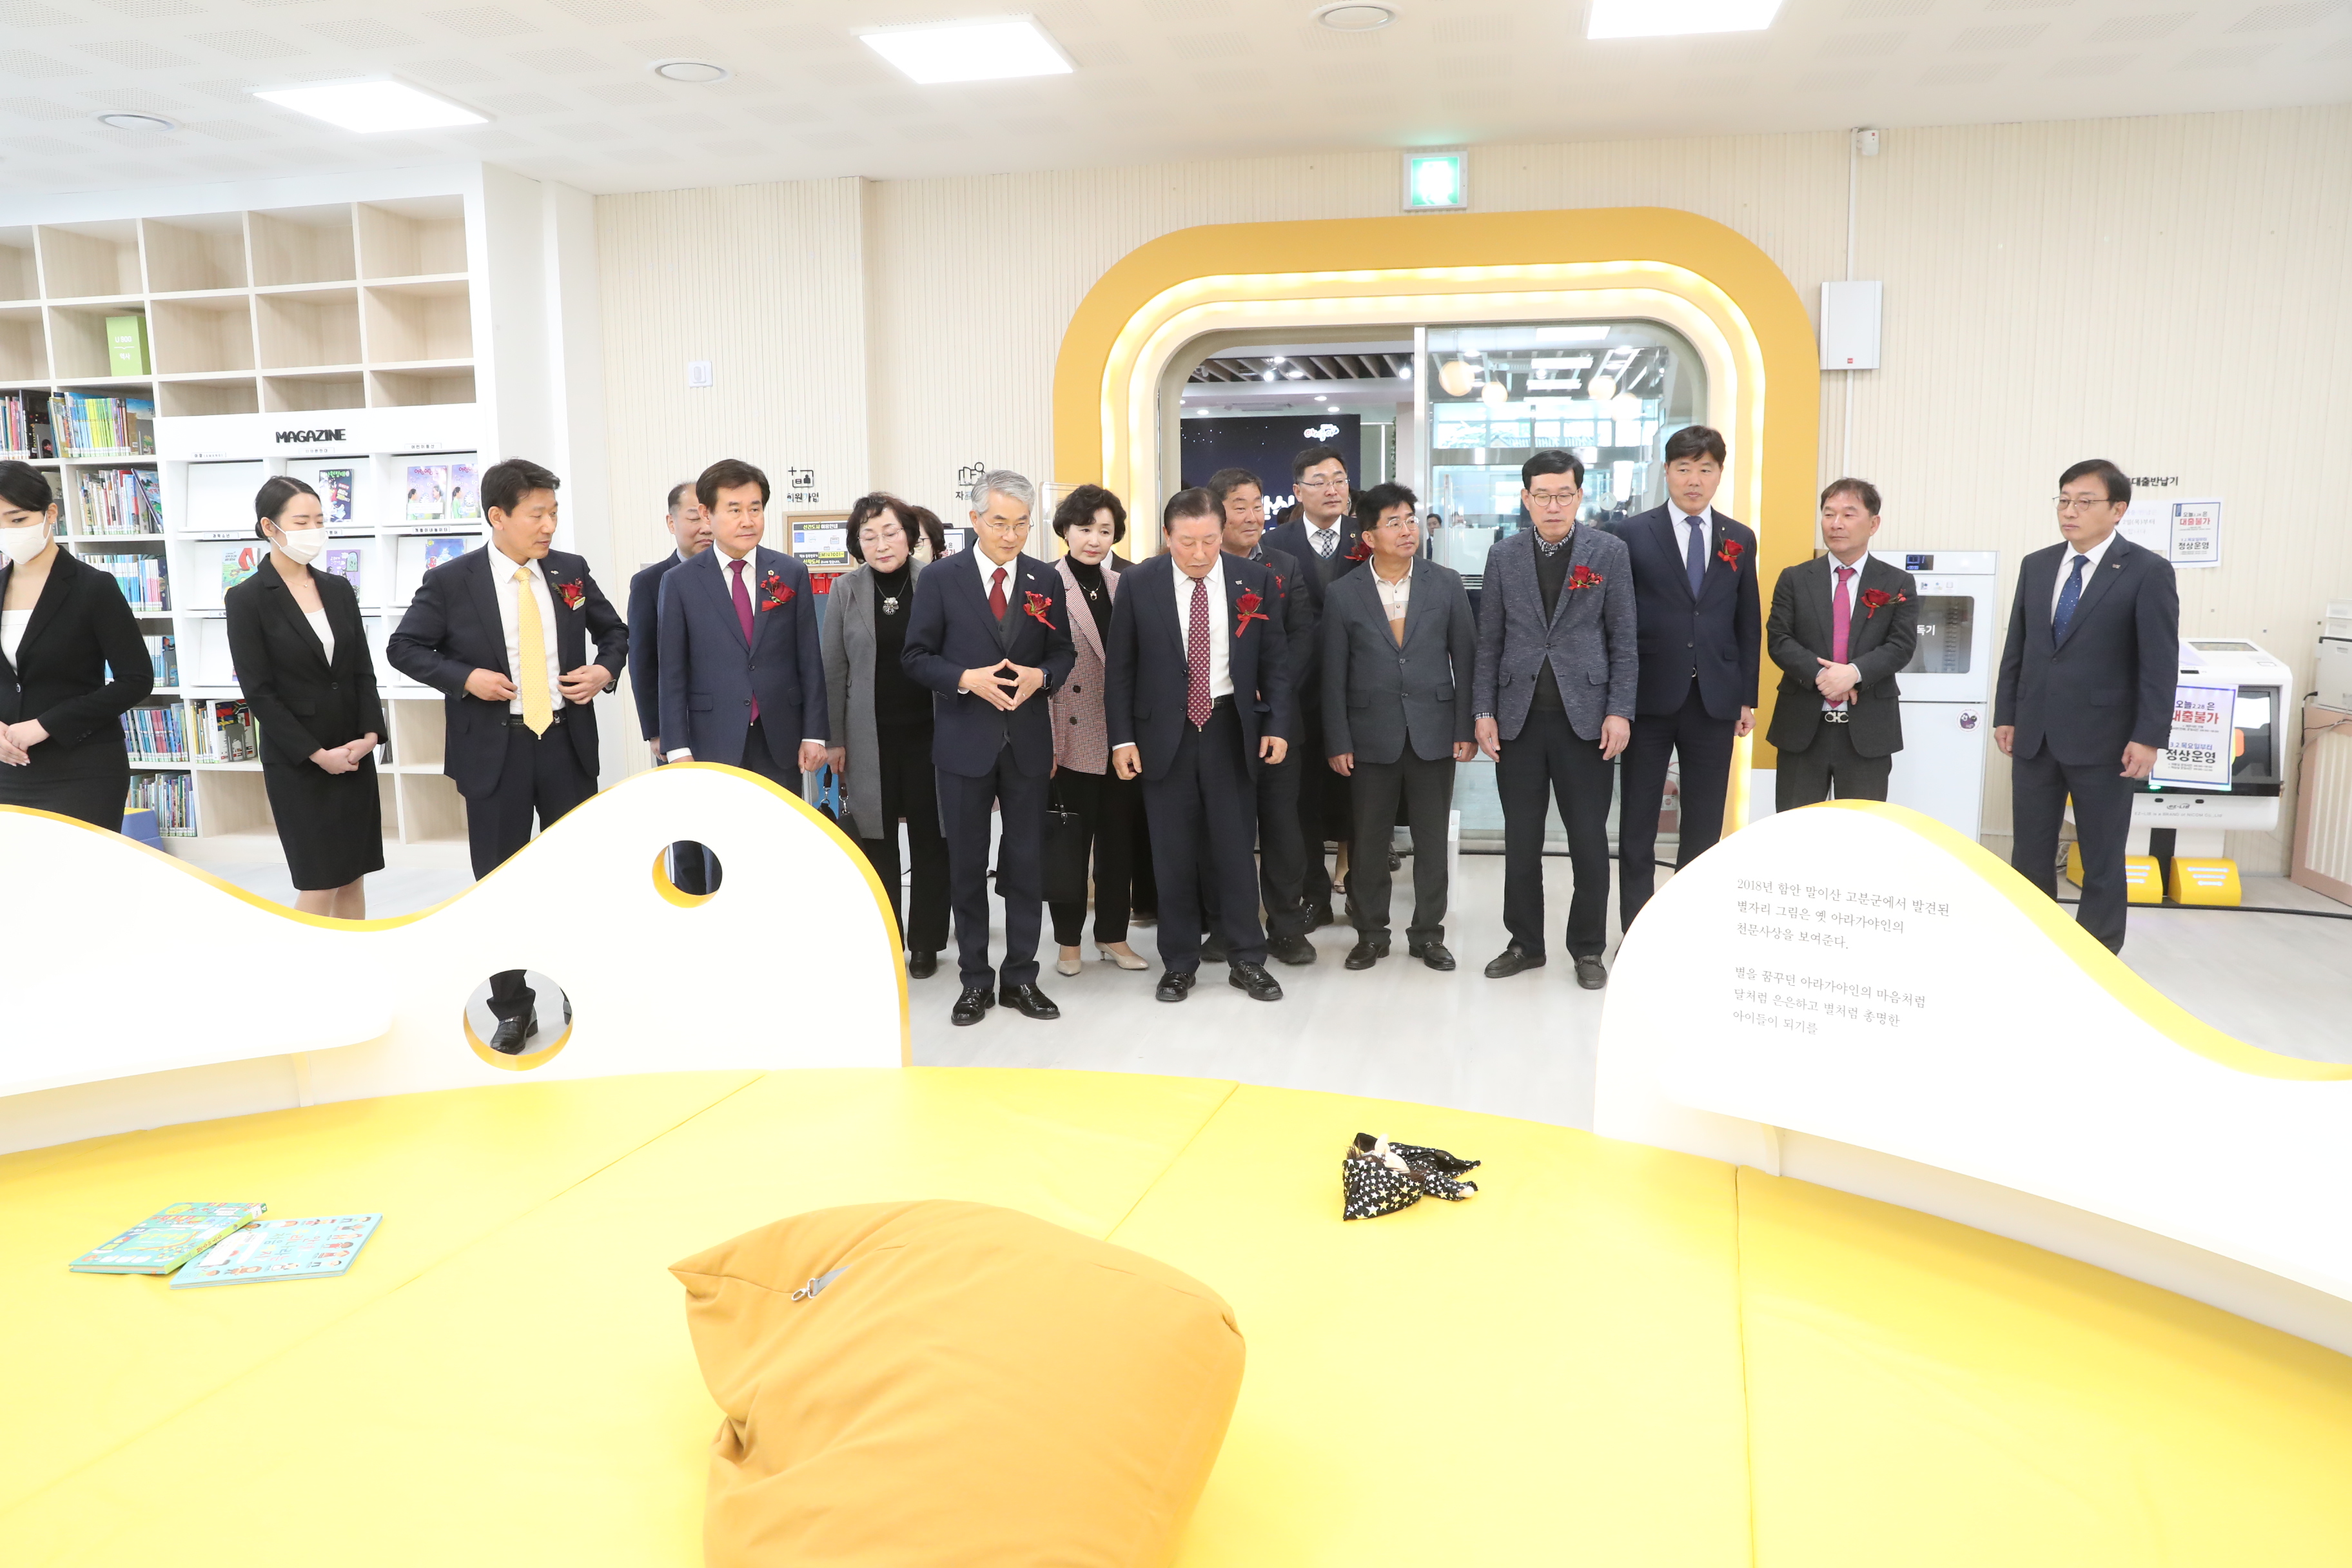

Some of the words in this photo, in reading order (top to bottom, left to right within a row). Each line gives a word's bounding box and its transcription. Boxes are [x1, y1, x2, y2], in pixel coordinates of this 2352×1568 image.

[276, 429, 346, 443] MAGAZINE
[2127, 476, 2179, 487] 대출반납기
[787, 492, 819, 502] 회원가입
[1917, 625, 1936, 636] 독기
[2206, 702, 2215, 710] 은
[2166, 749, 2216, 764] 정상운영
[1738, 879, 1773, 894] 2018년
[1778, 883, 1801, 896] 함안
[1806, 886, 1842, 901] 말이산
[1846, 892, 1906, 910] 고분군에서
[1912, 900, 1949, 917] 발견된
[1738, 901, 1770, 916] 별자리
[1776, 906, 1811, 921] 그림은
[1816, 910, 1826, 923] 옛
[1832, 912, 1903, 934] 아라가야인의
[1737, 923, 1794, 941] 천문사상을
[1798, 932, 1849, 950] 보여준다.
[1736, 966, 1758, 980] 별을
[1761, 970, 1795, 986] 꿈꾸던
[1801, 976, 1871, 999] 아라가야인의
[1877, 989, 1925, 1008] 마음처럼
[1734, 988, 1767, 1004] 달처럼
[1773, 995, 1818, 1011] 은은하고
[1824, 1003, 1857, 1019] 별처럼
[1863, 1010, 1900, 1027] 총명한
[1733, 1010, 1778, 1028] 아이들이
[1783, 1019, 1818, 1035] 되기를
